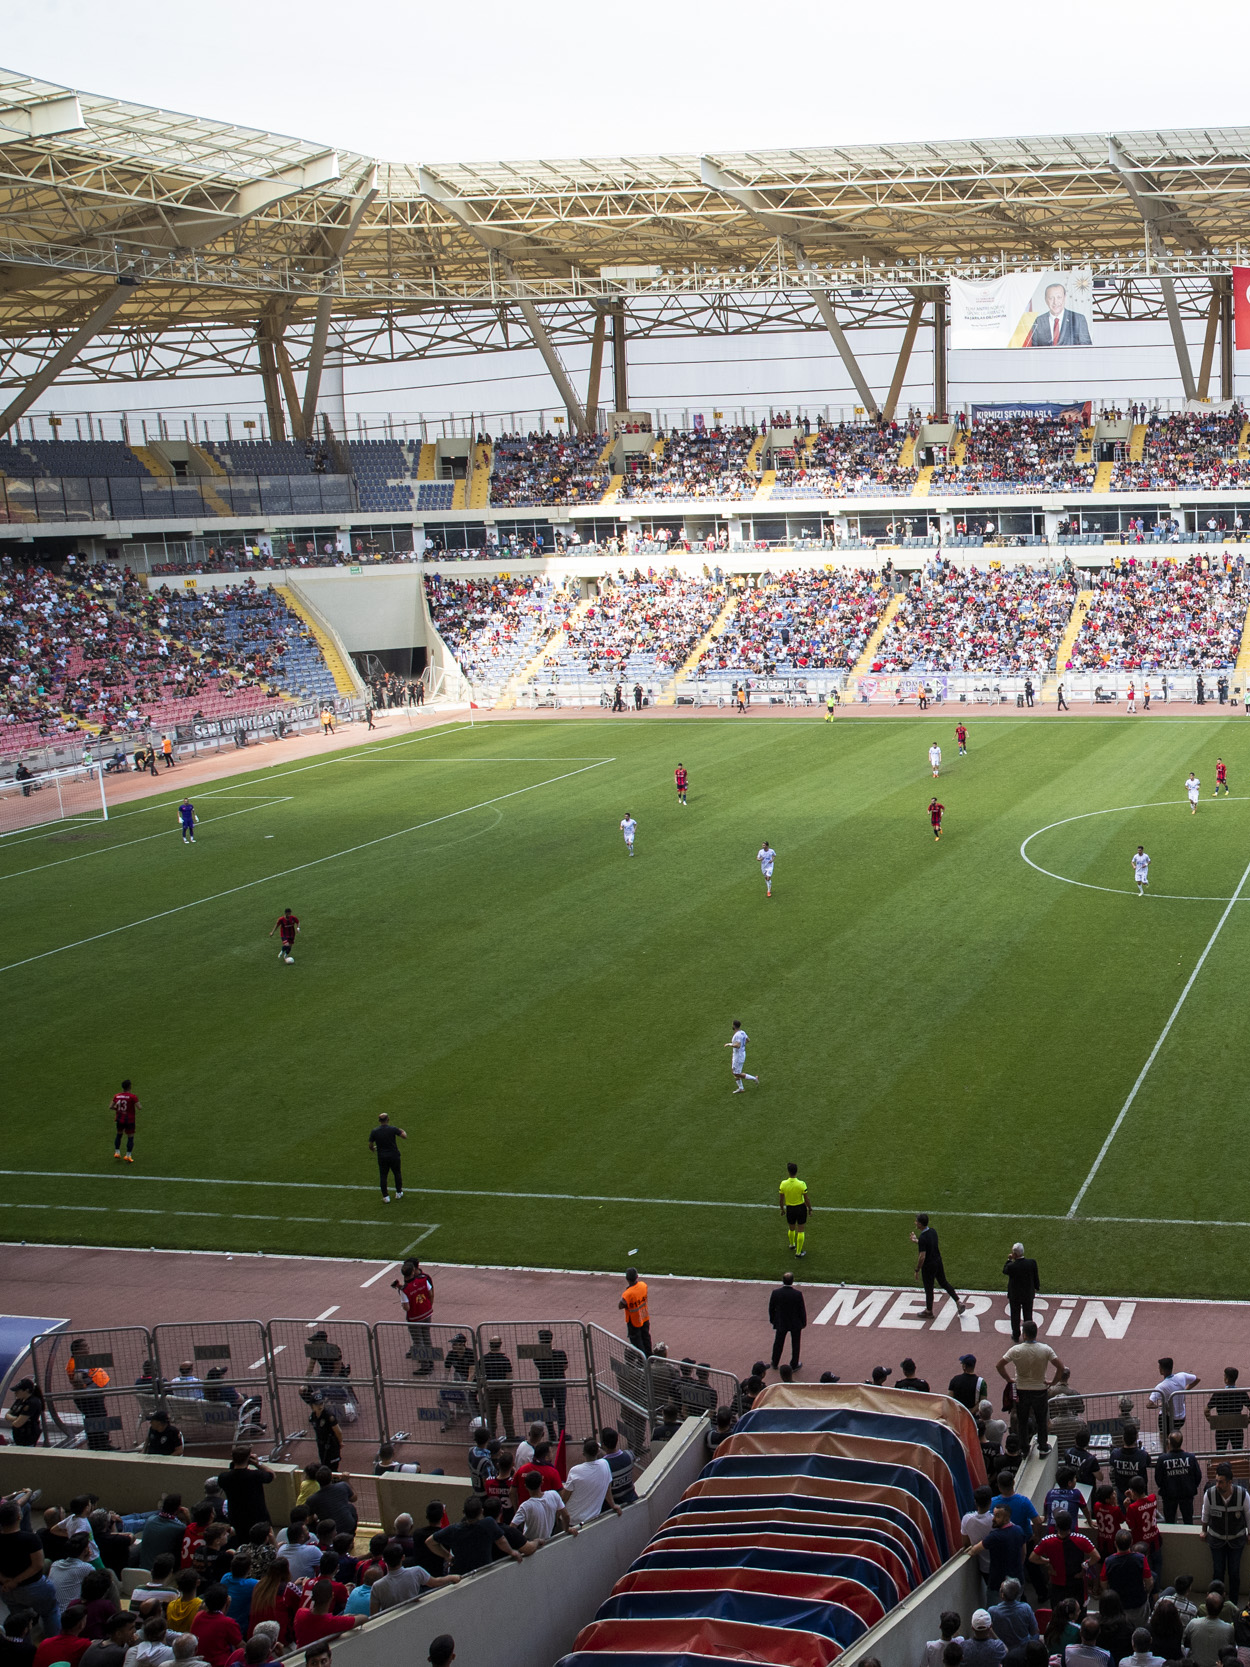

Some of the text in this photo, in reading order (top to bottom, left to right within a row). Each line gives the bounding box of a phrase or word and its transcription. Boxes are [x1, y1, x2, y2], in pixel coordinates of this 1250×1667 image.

[812, 1289, 1136, 1340] MERSİN
[1114, 1460, 1140, 1472] TEM
[1164, 1456, 1190, 1470] TEM
[1166, 1468, 1188, 1476] MERSİN
[1096, 1512, 1115, 1534] 33
